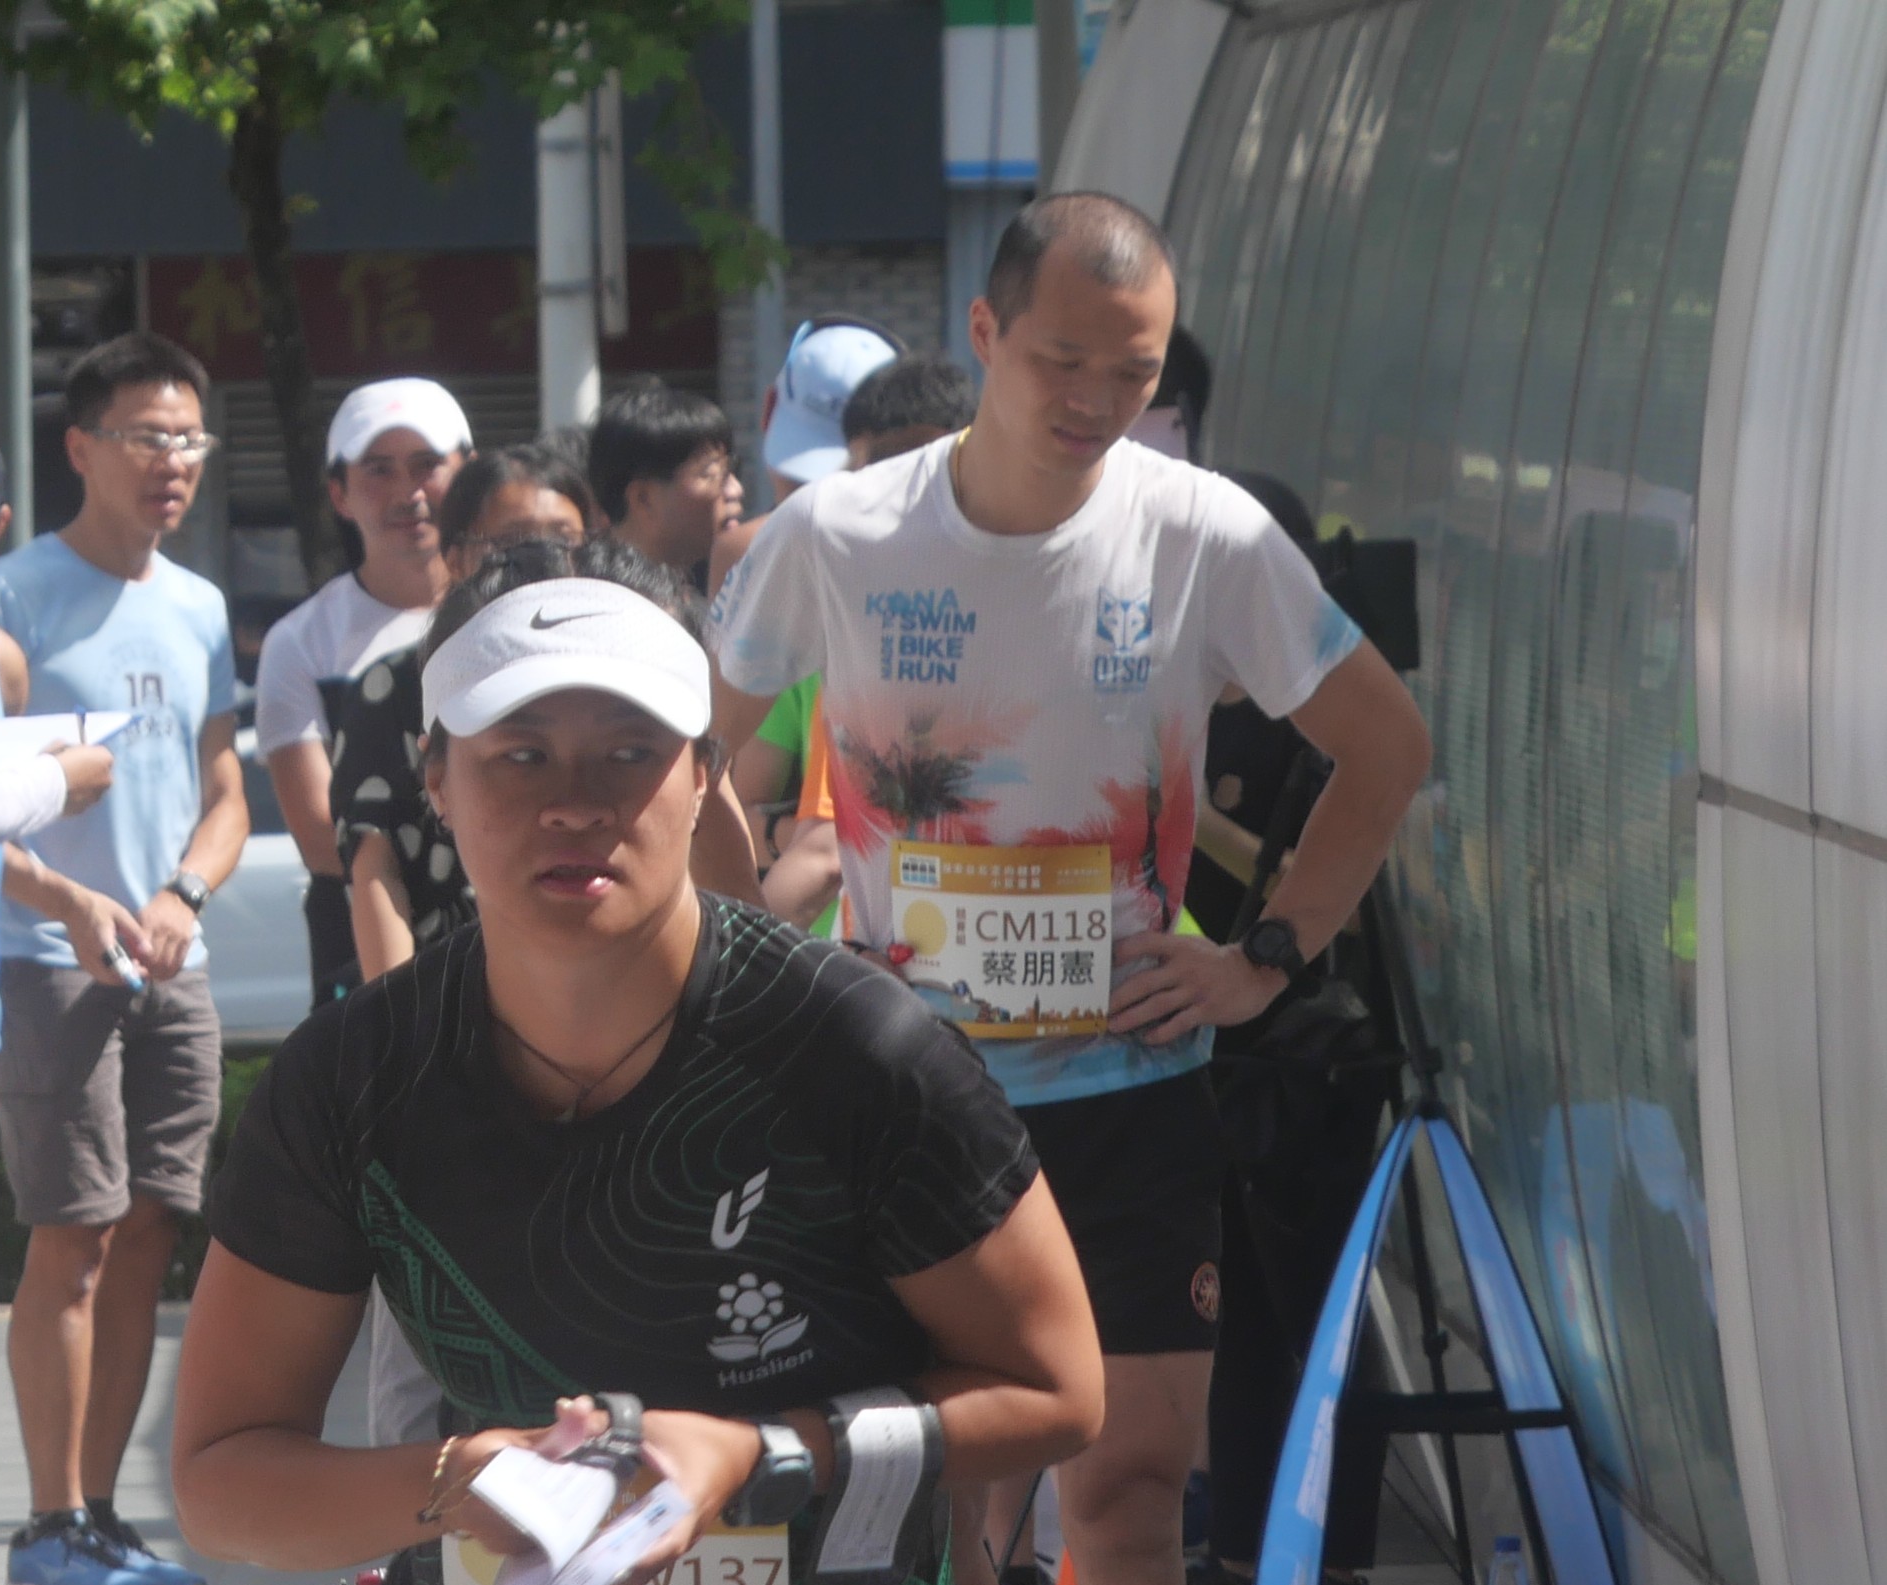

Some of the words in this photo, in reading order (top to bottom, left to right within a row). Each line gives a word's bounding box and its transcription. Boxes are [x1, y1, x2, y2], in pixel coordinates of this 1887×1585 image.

[899, 611, 976, 635] SWIM
[899, 635, 964, 660] BIKE
[897, 659, 957, 684] RUN
[1094, 653, 1151, 683] OTSO
[976, 909, 1107, 942] CM118
[982, 949, 1094, 986] 蔡朋憲
[718, 1349, 814, 1389] Hualien
